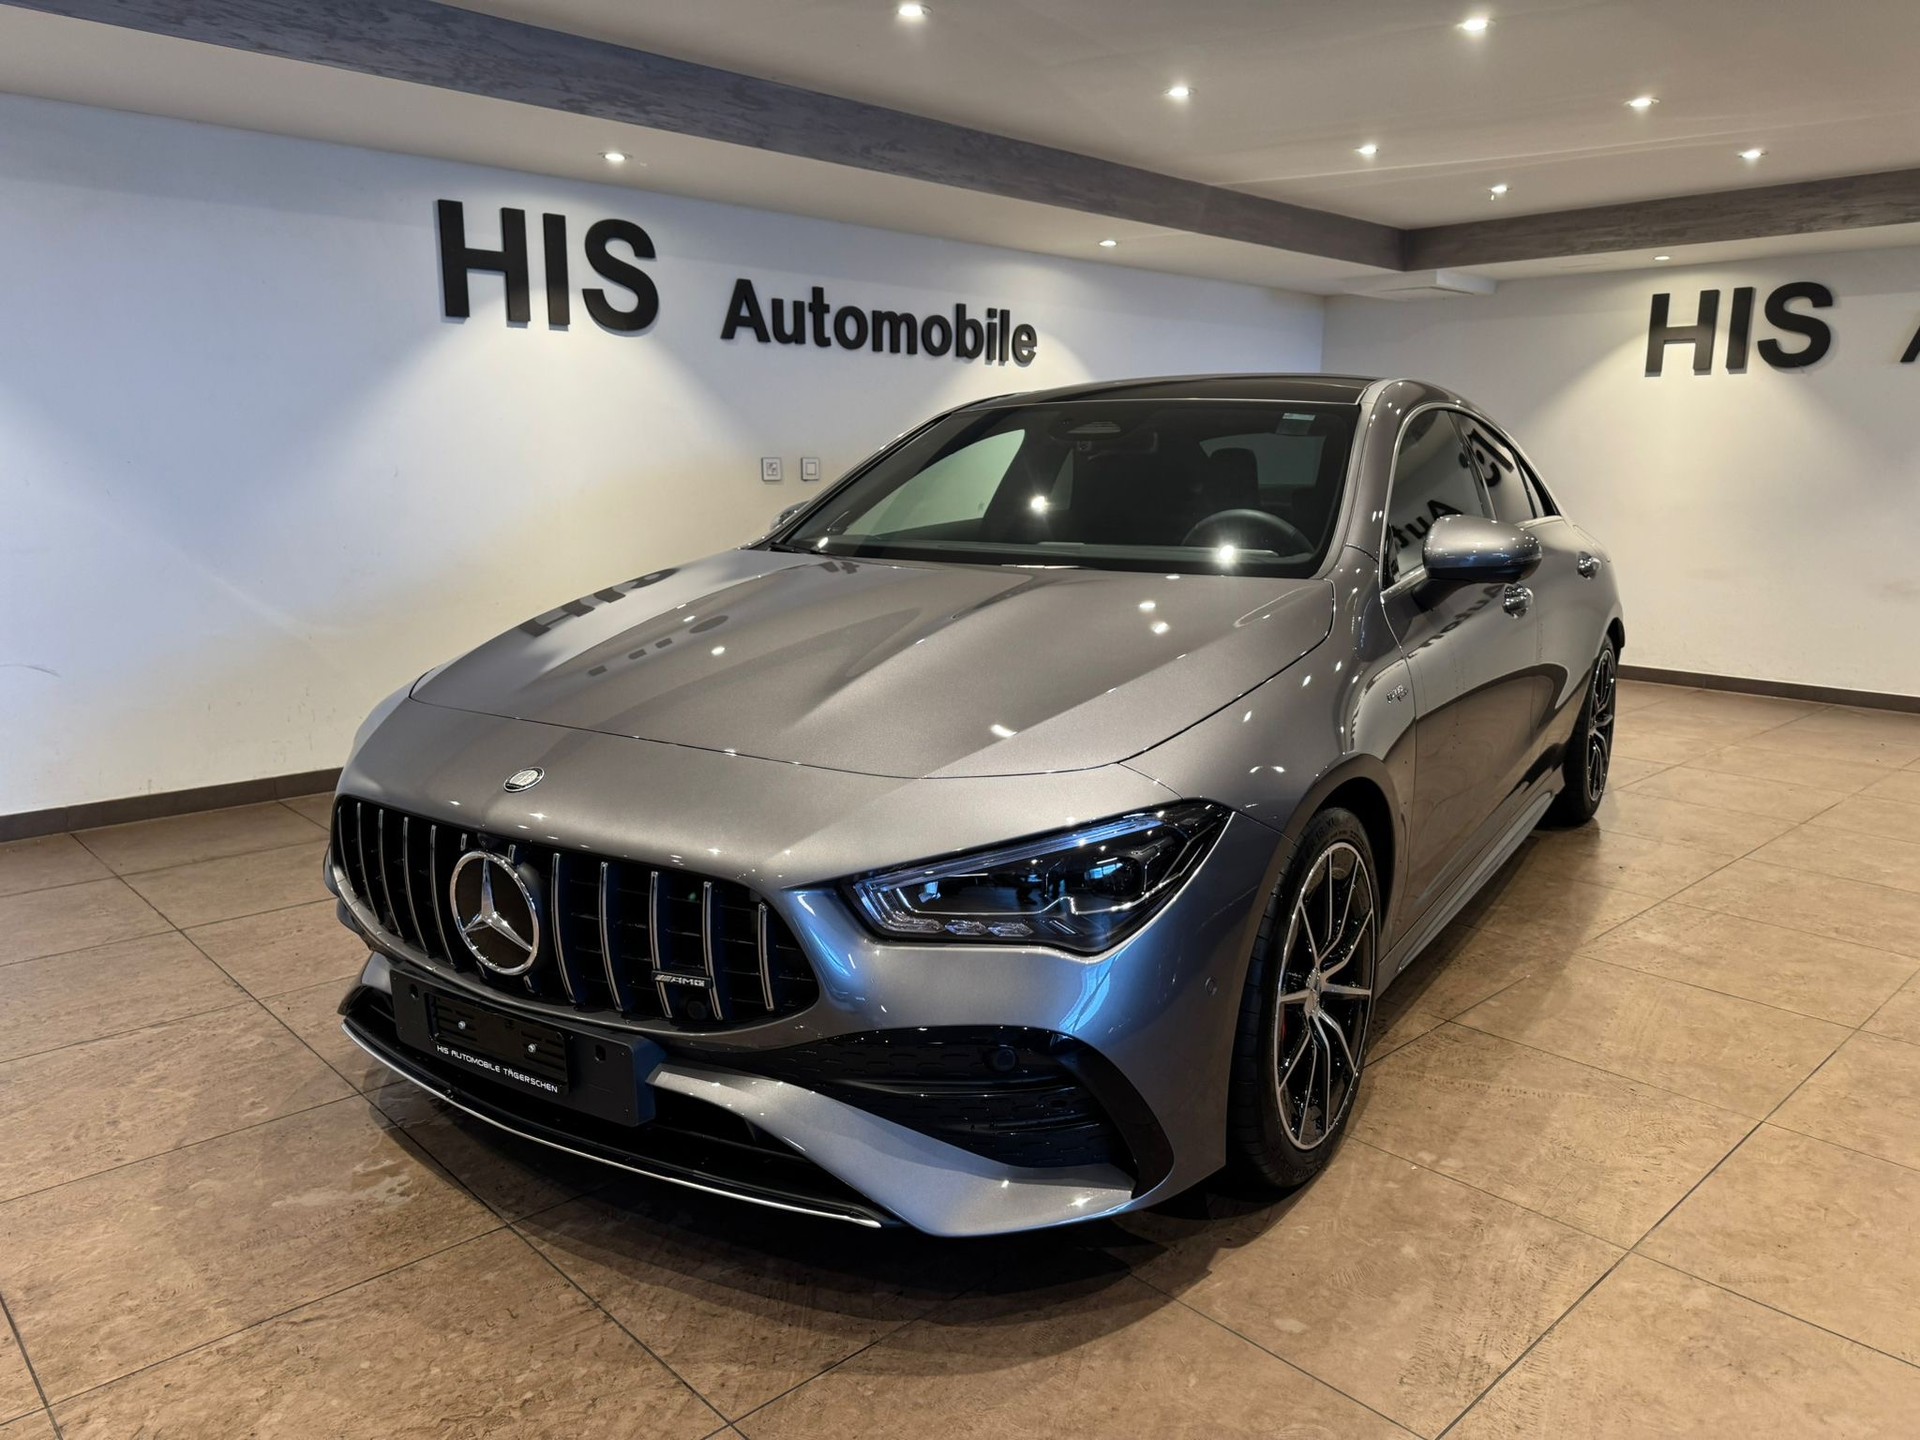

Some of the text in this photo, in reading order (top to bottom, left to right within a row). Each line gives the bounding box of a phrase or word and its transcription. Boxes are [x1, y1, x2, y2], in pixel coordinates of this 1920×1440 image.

[438, 198, 1038, 365] HIS Automobile
[1645, 281, 1834, 374] HIS
[436, 1044, 558, 1093] HIS AUTOMOBILE TÄGERSCHEN
